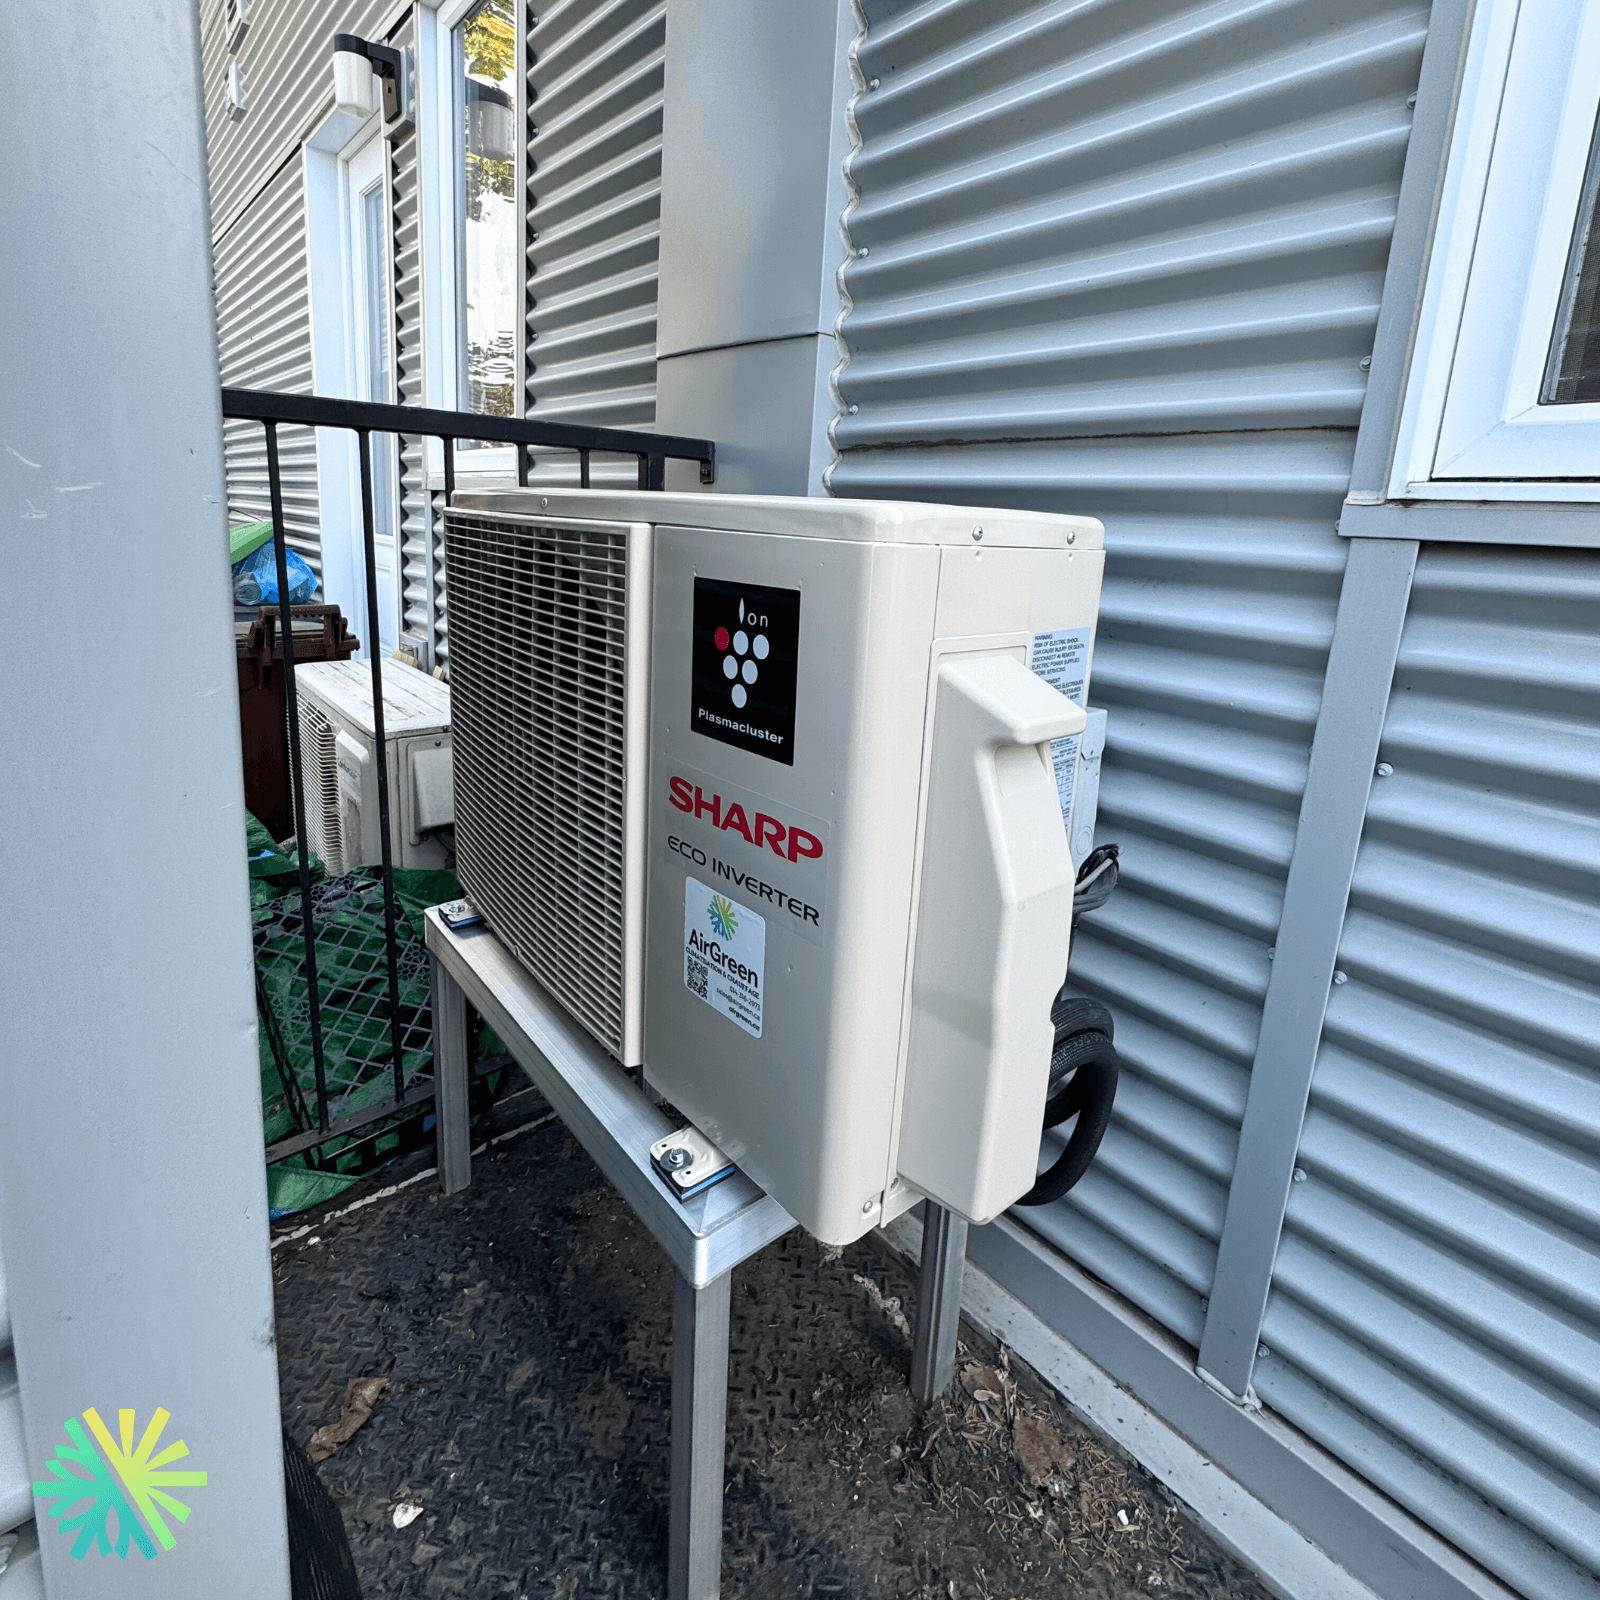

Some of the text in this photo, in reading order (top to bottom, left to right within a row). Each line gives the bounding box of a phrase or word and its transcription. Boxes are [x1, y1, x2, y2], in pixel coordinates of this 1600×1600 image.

[739, 597, 769, 628] Ion
[1033, 654, 1056, 662] DISCONNECT
[698, 708, 783, 744] Plasmacluster
[668, 776, 824, 864] SHARP
[667, 835, 820, 928] ECO INVERTER
[688, 928, 758, 988] AirGreen
[727, 974, 760, 1000] CHAUFFAGE
[729, 1006, 761, 1031] airgreen.ca
